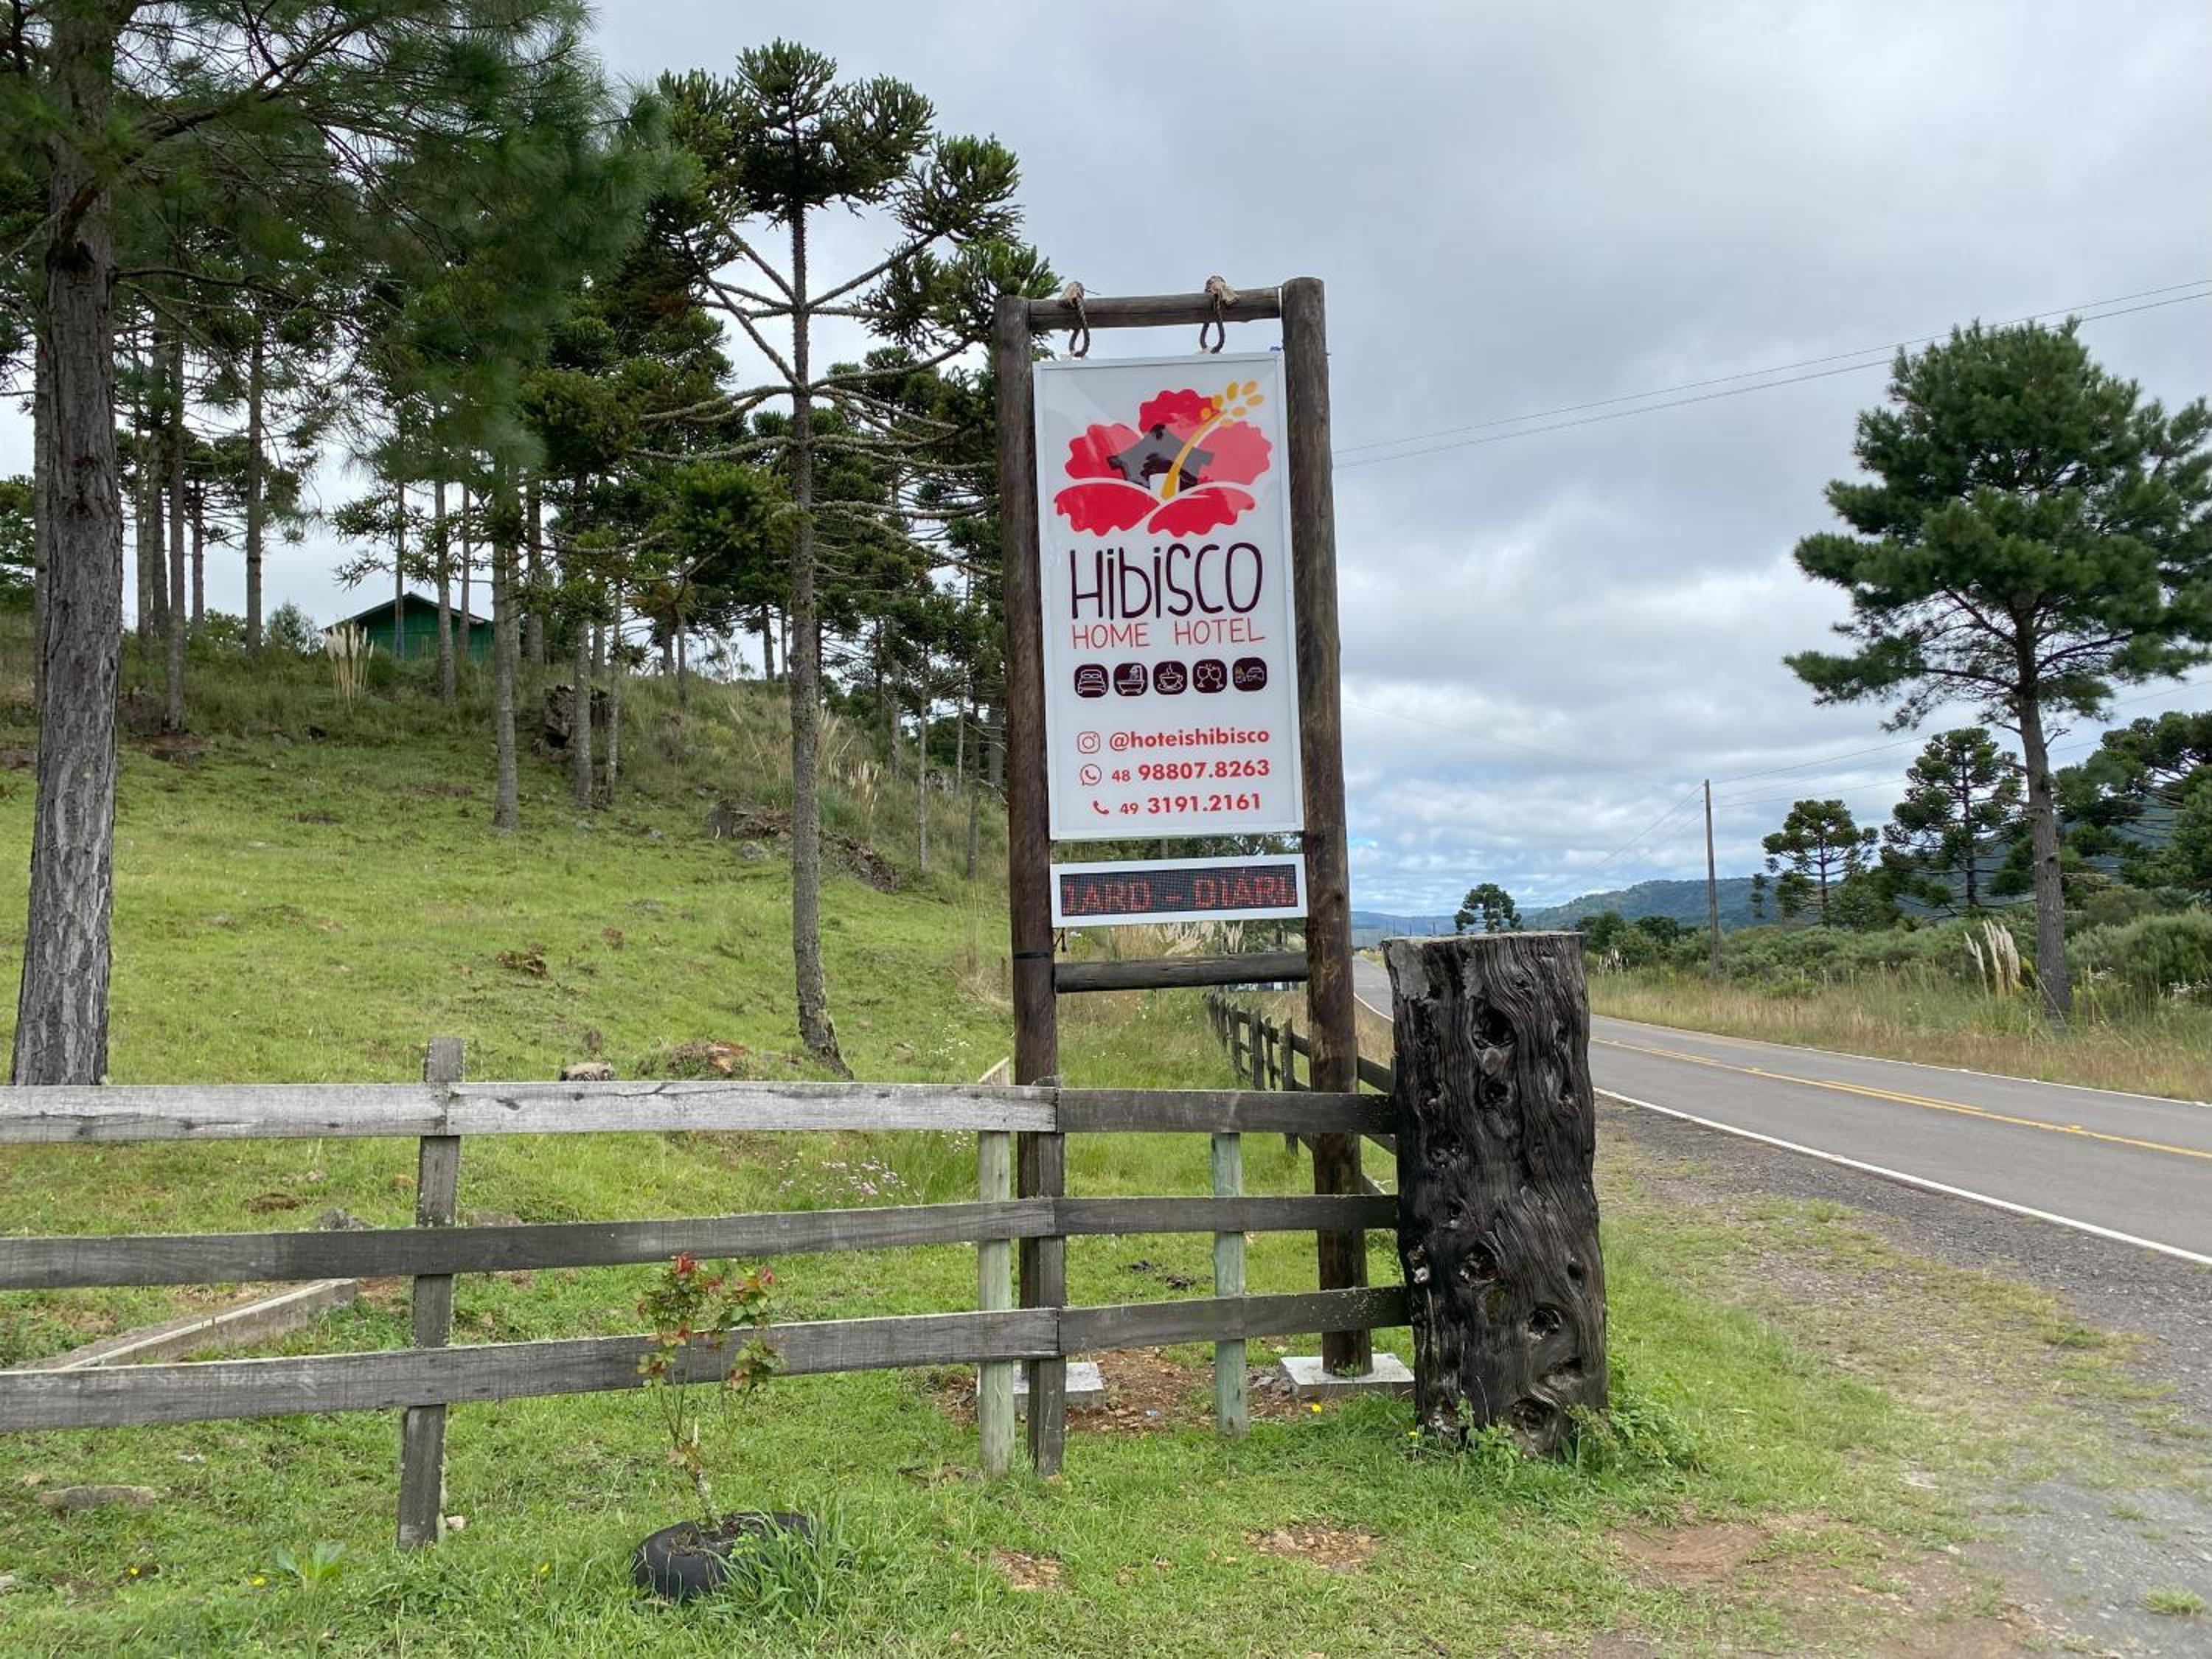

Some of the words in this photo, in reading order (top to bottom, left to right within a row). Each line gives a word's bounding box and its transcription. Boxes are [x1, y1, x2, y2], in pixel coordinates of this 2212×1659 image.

[1072, 622, 1150, 649] HOME
[1174, 617, 1266, 645] HOTEL
[1109, 727, 1270, 751] @hoteishibisco
[1111, 769, 1131, 782] 48
[1138, 759, 1270, 781] 98807.8263
[1120, 802, 1139, 814] 49
[1147, 793, 1261, 814] 3191.2161
